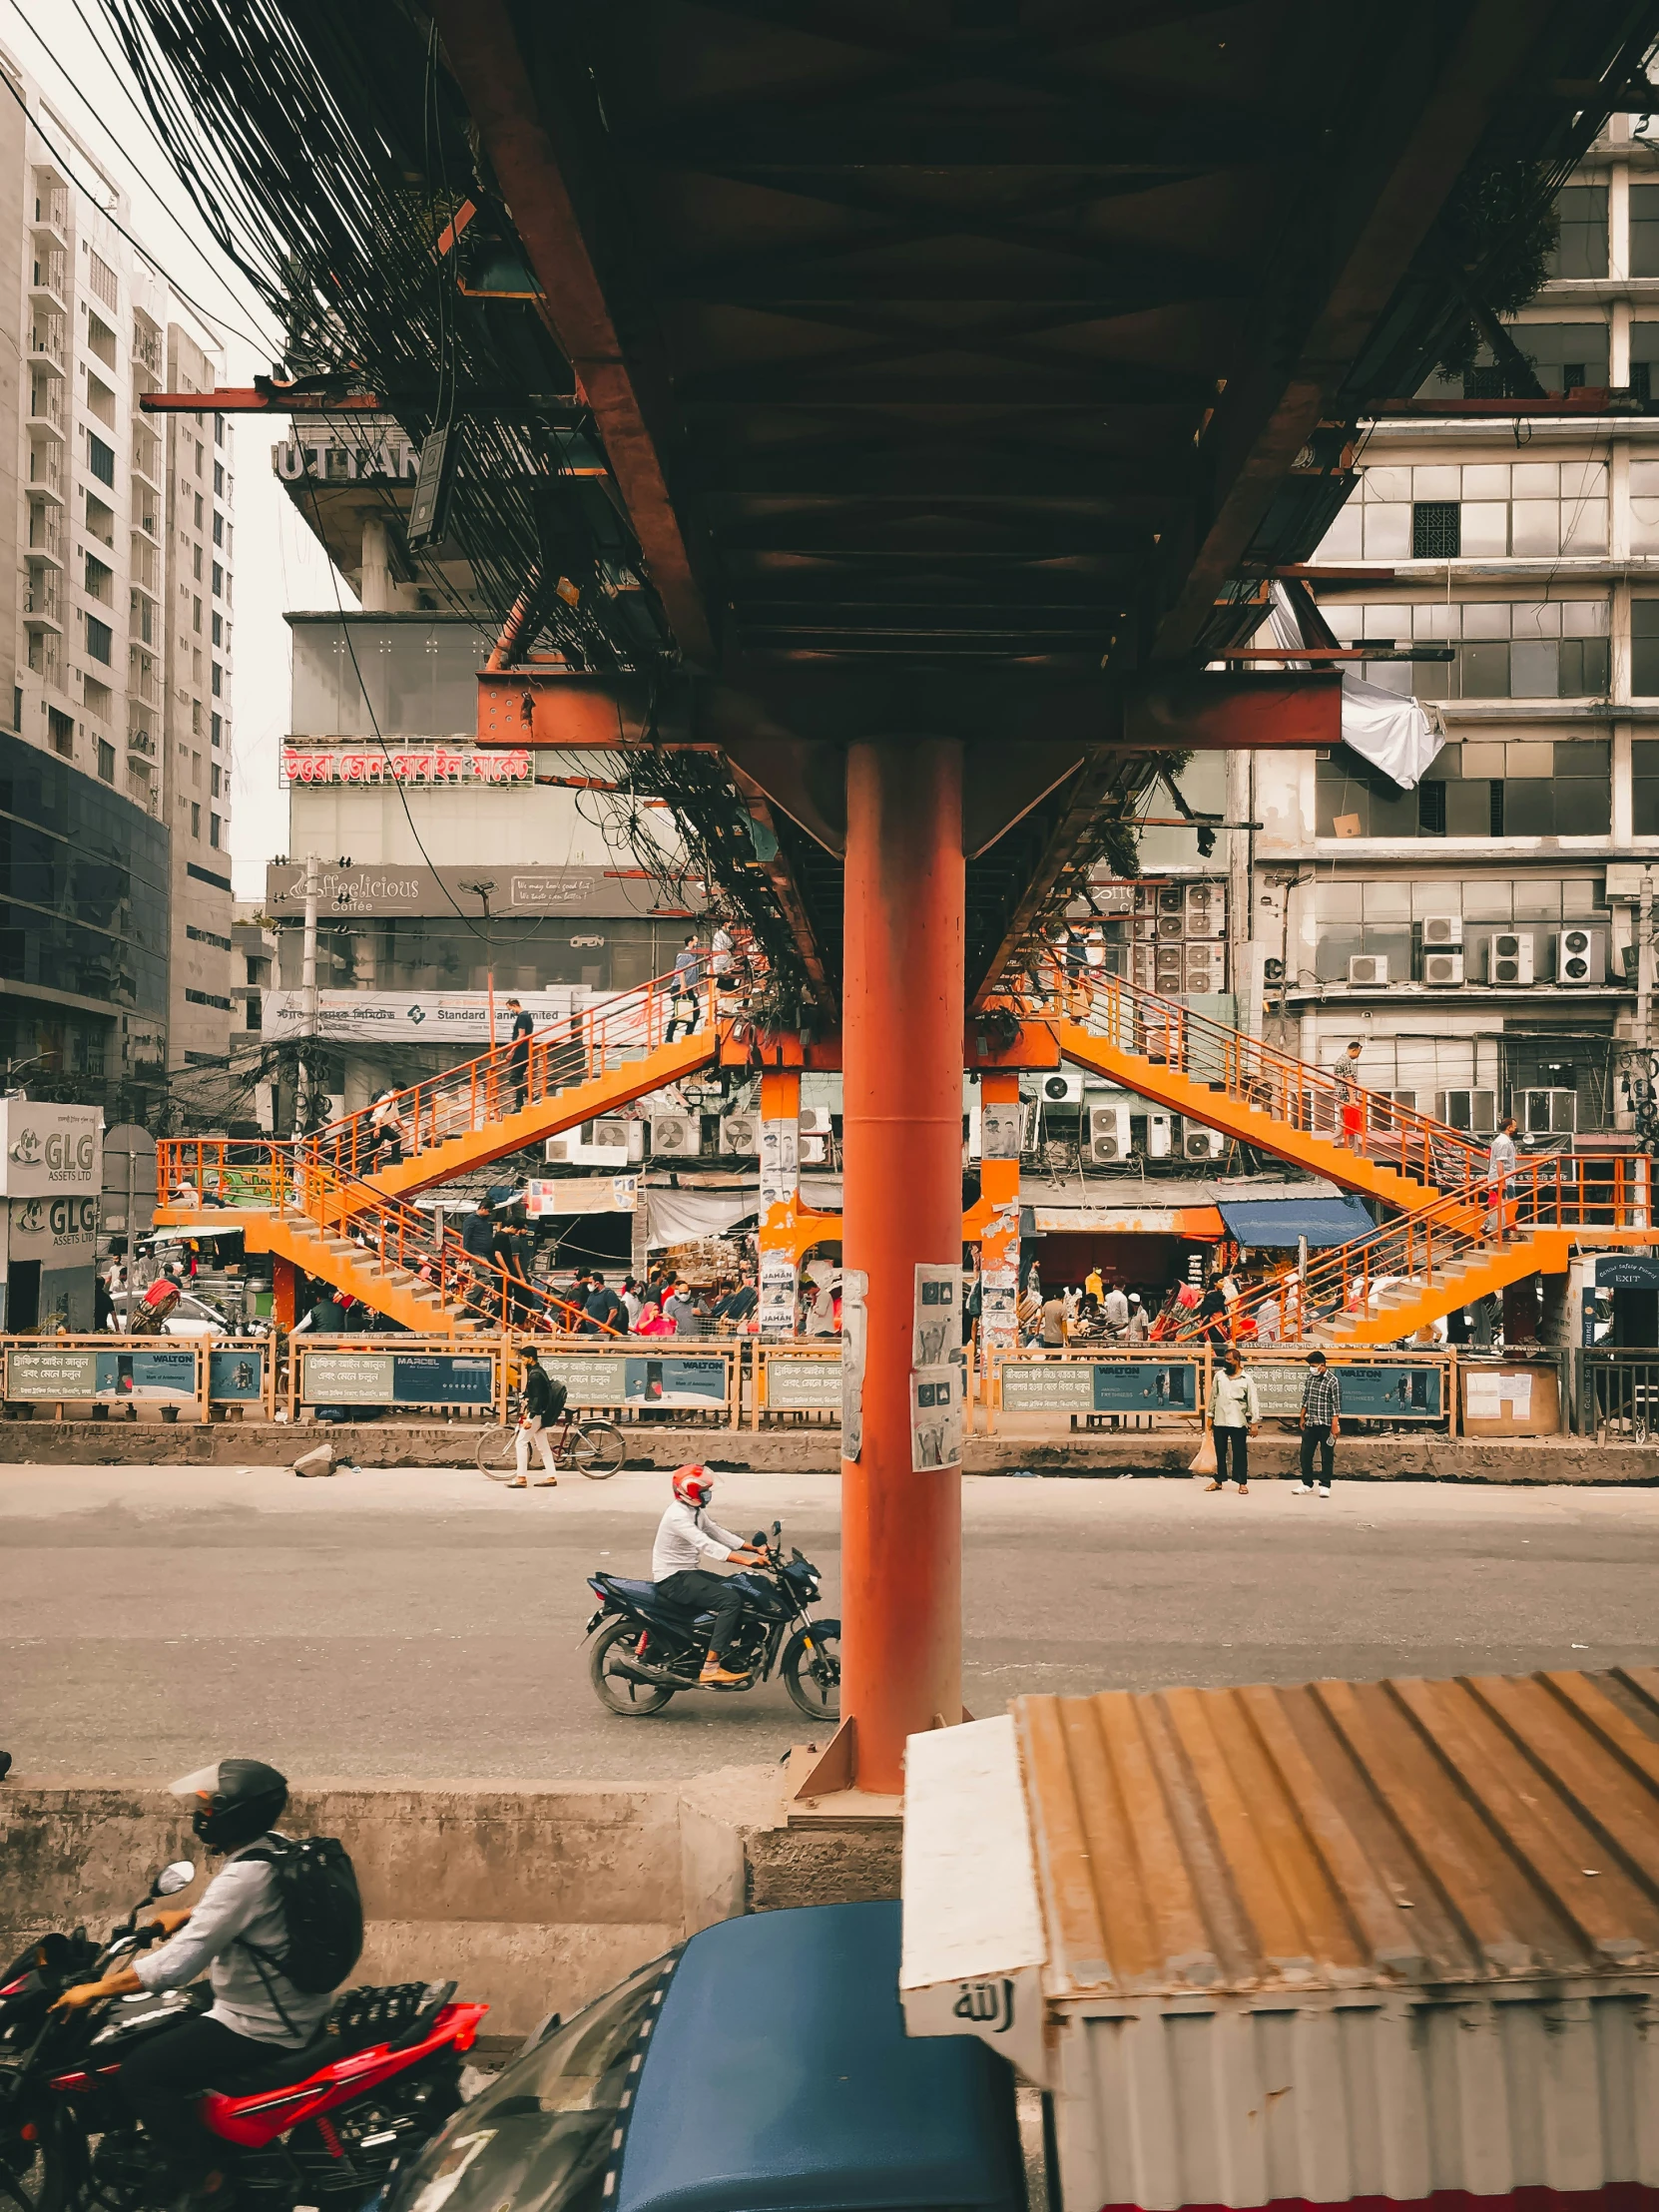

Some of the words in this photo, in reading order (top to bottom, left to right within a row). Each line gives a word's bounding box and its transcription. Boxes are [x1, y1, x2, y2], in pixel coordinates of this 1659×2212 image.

[282, 748, 334, 784] উত্তরা
[339, 755, 386, 784] জোন
[391, 746, 463, 784] মোবাইল
[472, 749, 531, 782] মার্কেট
[562, 881, 578, 891] good
[570, 935, 605, 948] OPEN
[437, 1009, 486, 1020] Standard
[493, 1009, 517, 1020] ank
[530, 1010, 559, 1020] mited
[45, 1133, 94, 1171] GLG
[48, 1171, 76, 1181] ASSETS
[78, 1170, 92, 1181] LTD
[49, 1198, 95, 1235] GLG
[53, 1234, 80, 1246] ASSETS
[81, 1233, 94, 1243] LTD
[1615, 1274, 1641, 1283] EXIT
[13, 1355, 40, 1367] ট্রাফিক
[41, 1357, 63, 1367] আইন
[65, 1358, 89, 1368] জানুন
[309, 1358, 336, 1369] ট্রাফিক
[338, 1359, 360, 1369] আইন
[362, 1360, 386, 1371] জানুন
[570, 1361, 593, 1371] আইন
[594, 1363, 618, 1374] জানুন
[21, 1369, 38, 1379] এবং
[40, 1369, 60, 1378] মেনে
[61, 1370, 81, 1380] চলুন
[317, 1372, 335, 1381] এবং
[337, 1372, 357, 1381] মেনে
[358, 1373, 379, 1382] চলুন
[590, 1375, 610, 1385] চলুন
